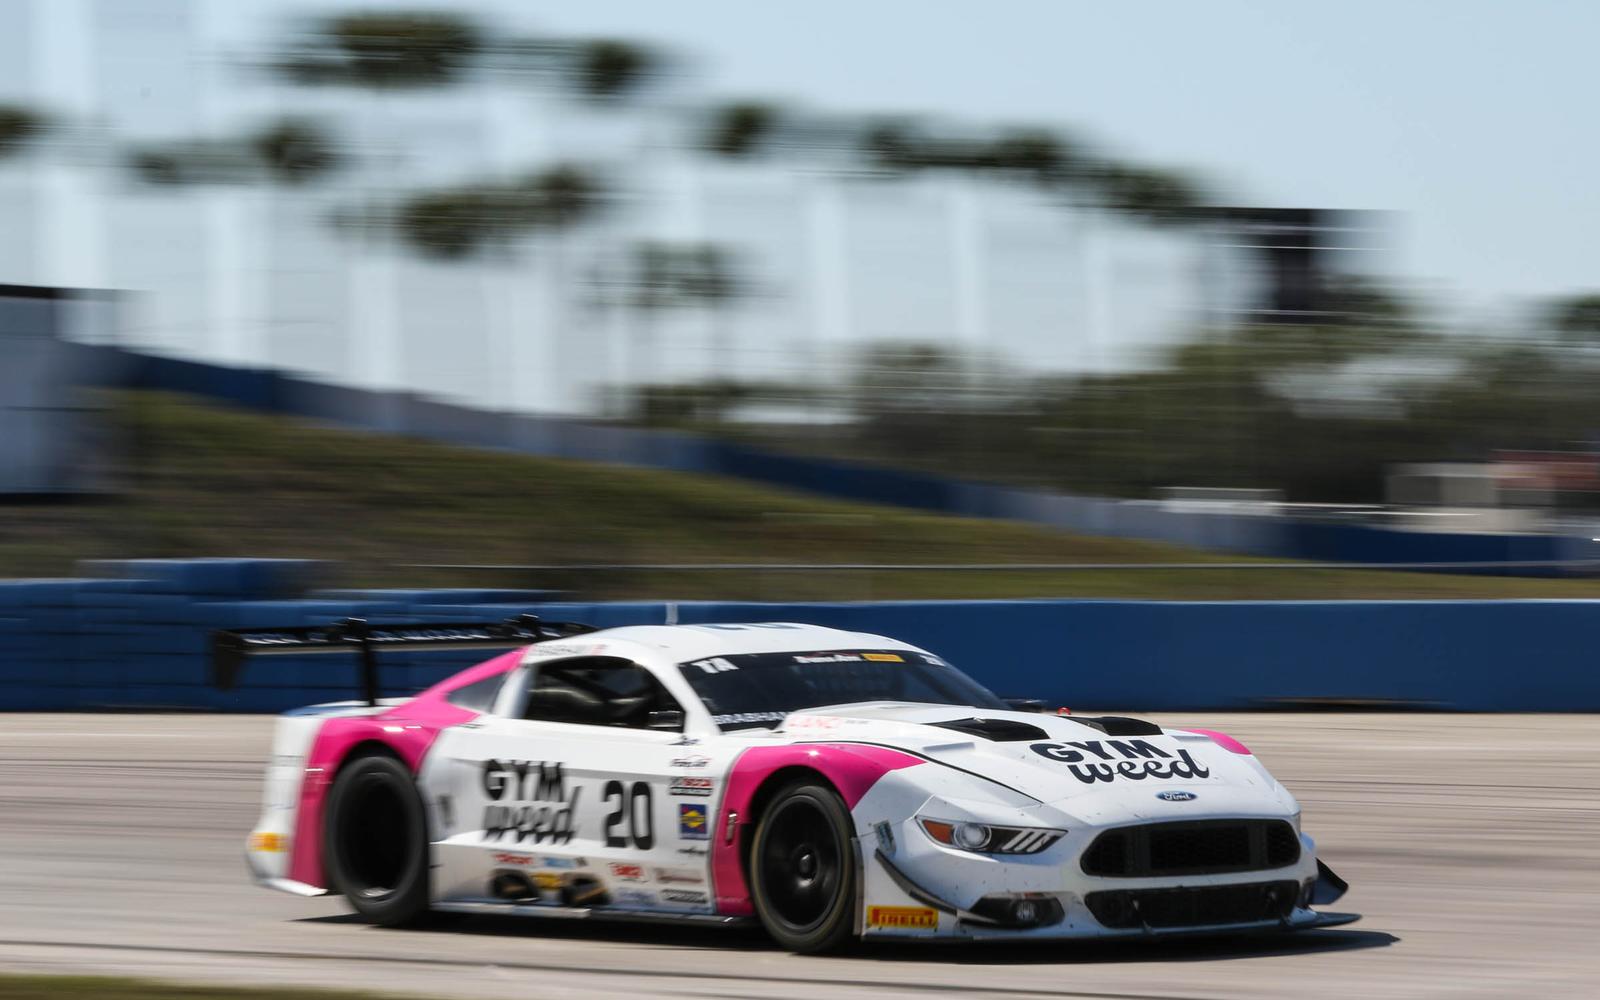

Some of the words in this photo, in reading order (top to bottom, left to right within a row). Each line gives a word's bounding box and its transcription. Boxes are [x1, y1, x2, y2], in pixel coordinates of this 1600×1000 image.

[1029, 739, 1173, 763] GYM
[1067, 749, 1209, 784] weed
[483, 758, 565, 801] GYM
[482, 786, 582, 844] weed
[602, 780, 654, 850] 20
[871, 907, 937, 929] PIRELLI
